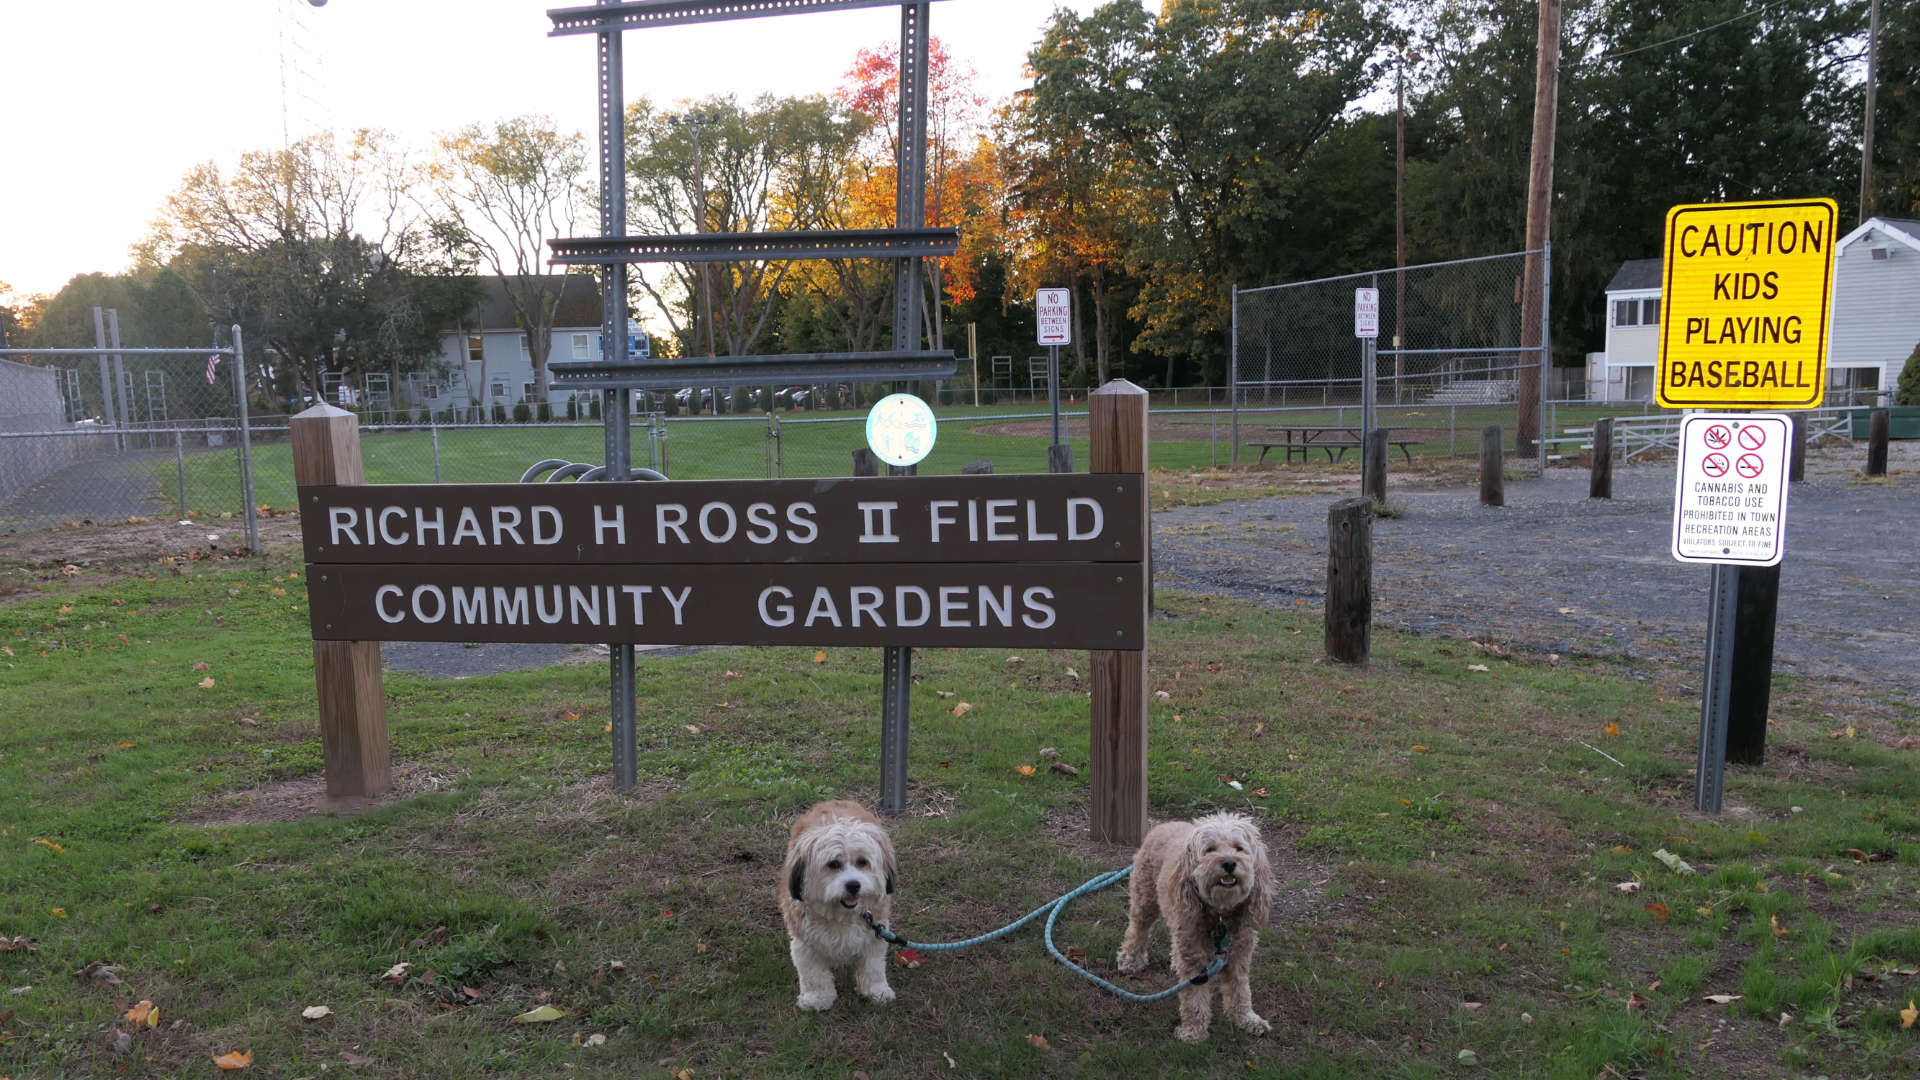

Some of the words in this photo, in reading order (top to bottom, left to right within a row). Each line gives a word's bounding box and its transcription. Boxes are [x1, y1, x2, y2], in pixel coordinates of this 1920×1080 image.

[1680, 220, 1823, 258] CAUTION
[1714, 271, 1779, 300] KIDS
[1047, 293, 1059, 304] NO
[1363, 293, 1371, 302] NO
[1039, 306, 1068, 317] PARKING
[1040, 317, 1067, 325] BETWEEN
[1043, 325, 1064, 333] SIGNS
[1686, 316, 1802, 344] PLAYING
[1671, 360, 1810, 388] BASEBALL
[1695, 482, 1743, 493] CANNABIS
[1748, 484, 1767, 493] AND
[1698, 496, 1740, 507] TOBACCO
[1745, 497, 1763, 507] USE
[1684, 510, 1733, 521] PROHIBITED
[1738, 512, 1746, 521] IN
[1751, 512, 1775, 522] TOWN
[329, 504, 564, 547] RICHARD
[594, 504, 626, 545] H
[657, 501, 819, 544] ROSS
[857, 501, 899, 544] II
[930, 497, 1104, 543] FIELD
[1685, 524, 1738, 535] RECREATION
[1742, 526, 1771, 536] AREAS
[1683, 538, 1715, 546] VIOLATORS
[374, 584, 694, 626] COMMUNITY
[757, 584, 1057, 629] GARDENS
